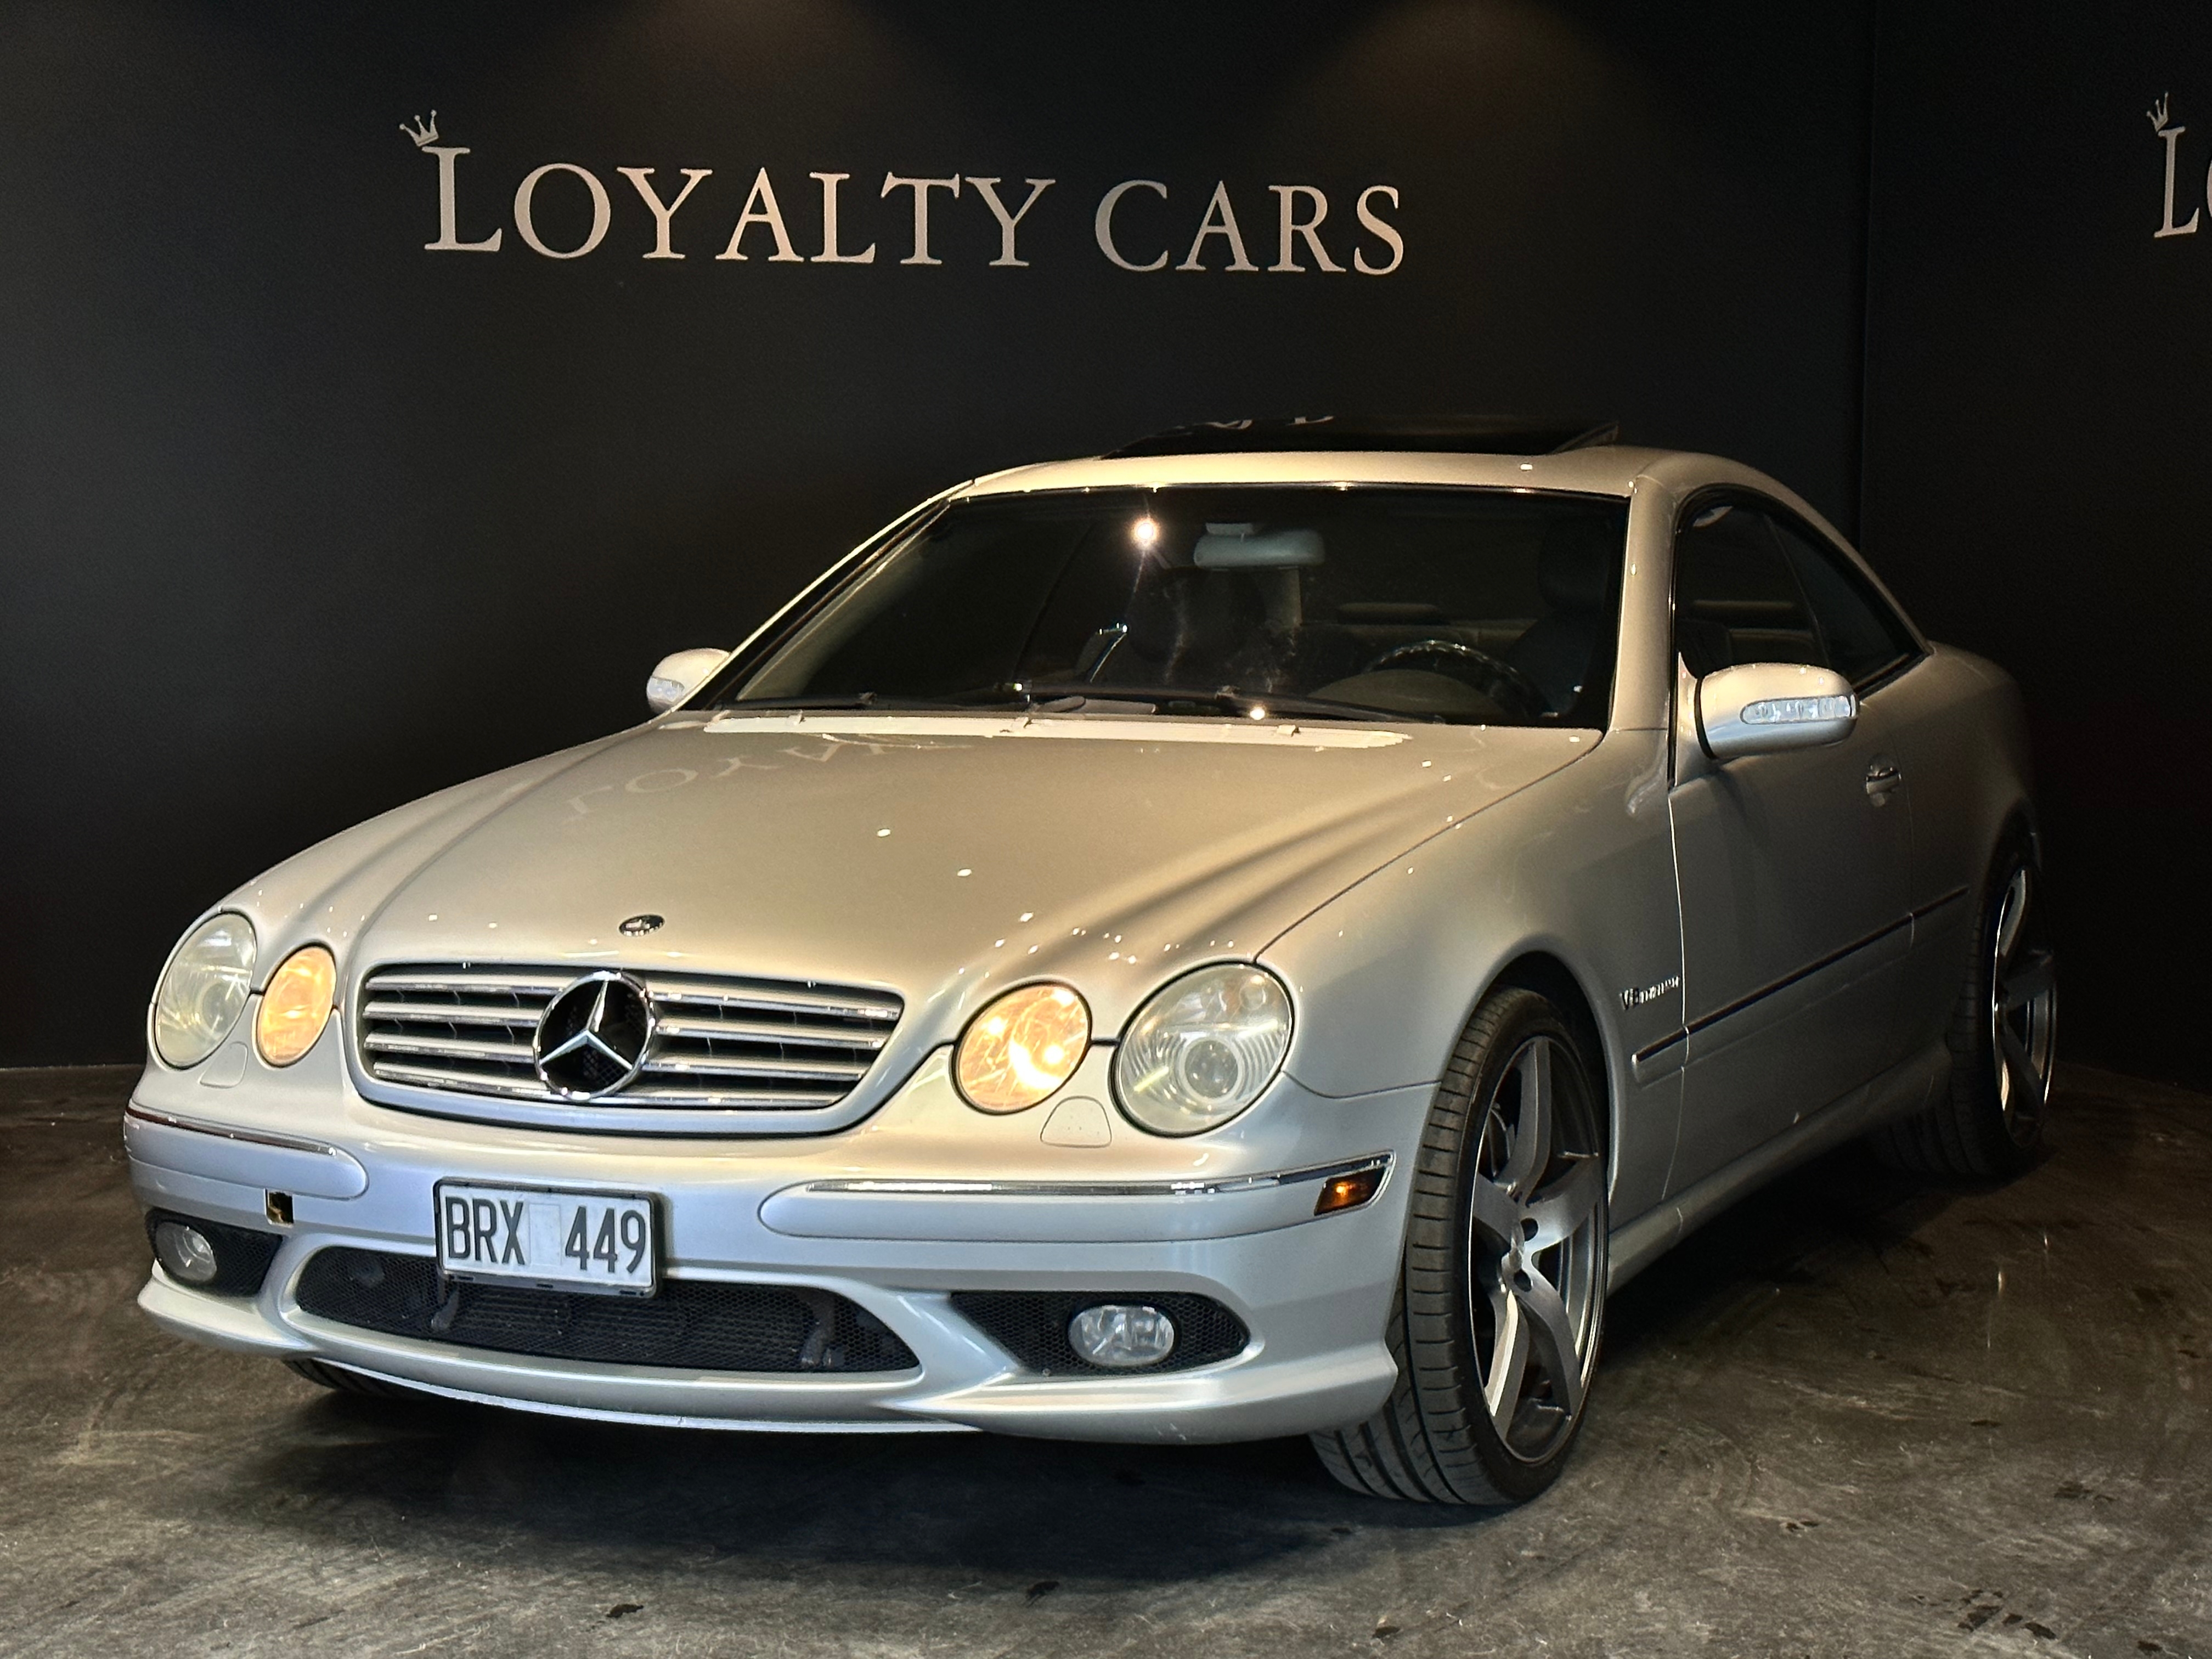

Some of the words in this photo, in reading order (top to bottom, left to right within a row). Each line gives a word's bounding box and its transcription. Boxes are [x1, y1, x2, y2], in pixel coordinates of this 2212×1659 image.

[421, 146, 1056, 267] LOYALTY
[1095, 179, 1404, 275] CARS
[2153, 126, 2212, 238] L
[445, 1196, 526, 1266] BRX
[565, 1206, 646, 1274] 449
